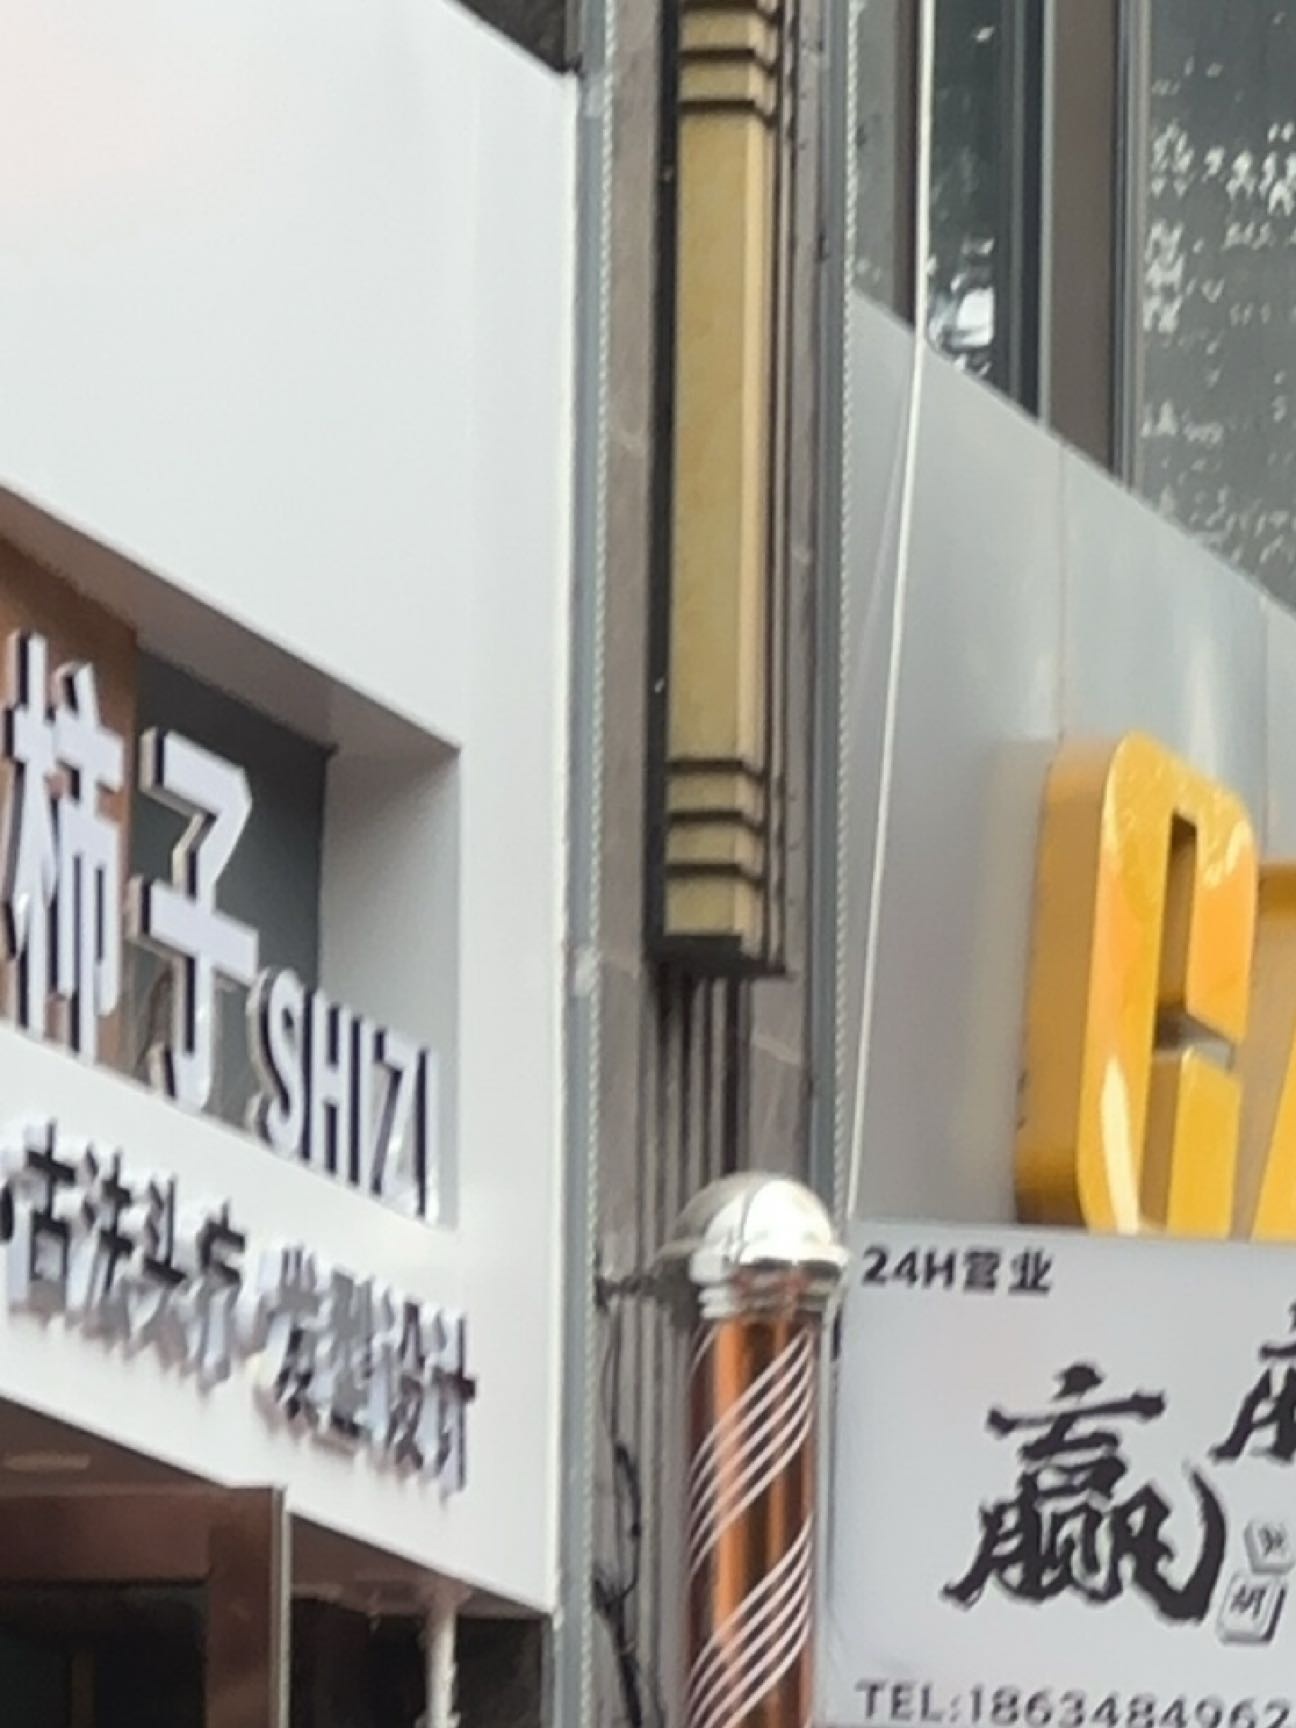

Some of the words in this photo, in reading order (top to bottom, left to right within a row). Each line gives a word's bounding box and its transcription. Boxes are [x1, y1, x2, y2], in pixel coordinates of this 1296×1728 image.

[0, 625, 262, 1112] 柿子
[252, 965, 438, 1222] SHIZI
[861, 1244, 1055, 1296] 24H营业
